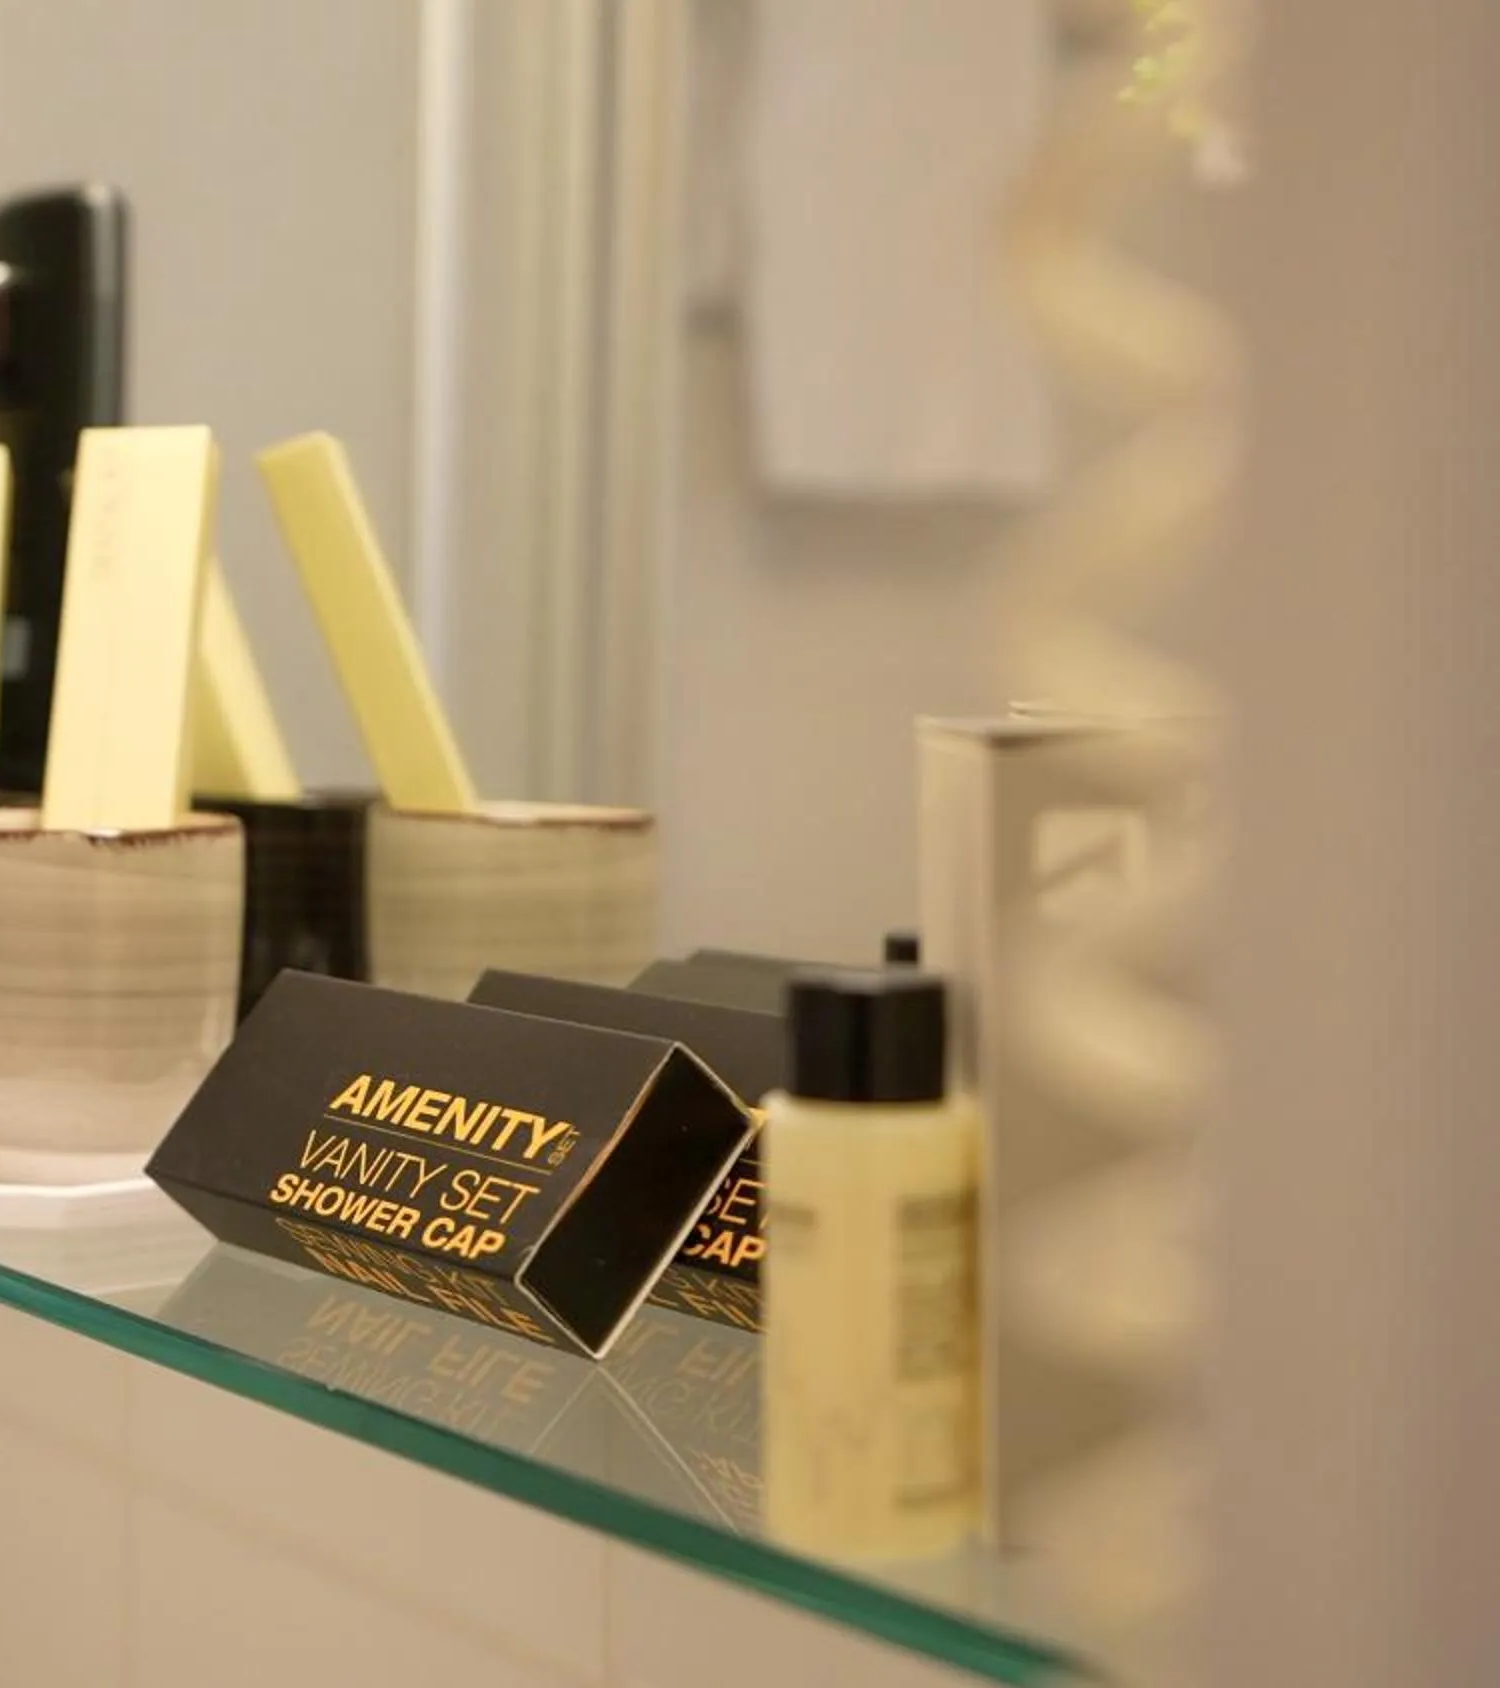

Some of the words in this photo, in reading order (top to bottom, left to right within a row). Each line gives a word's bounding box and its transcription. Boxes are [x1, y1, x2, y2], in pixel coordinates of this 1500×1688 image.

[329, 1075, 571, 1159] AMENITY
[270, 1173, 422, 1240] SHOWER
[421, 1217, 506, 1259] CAP
[300, 1129, 449, 1199] VANITY
[440, 1170, 541, 1224] SET
